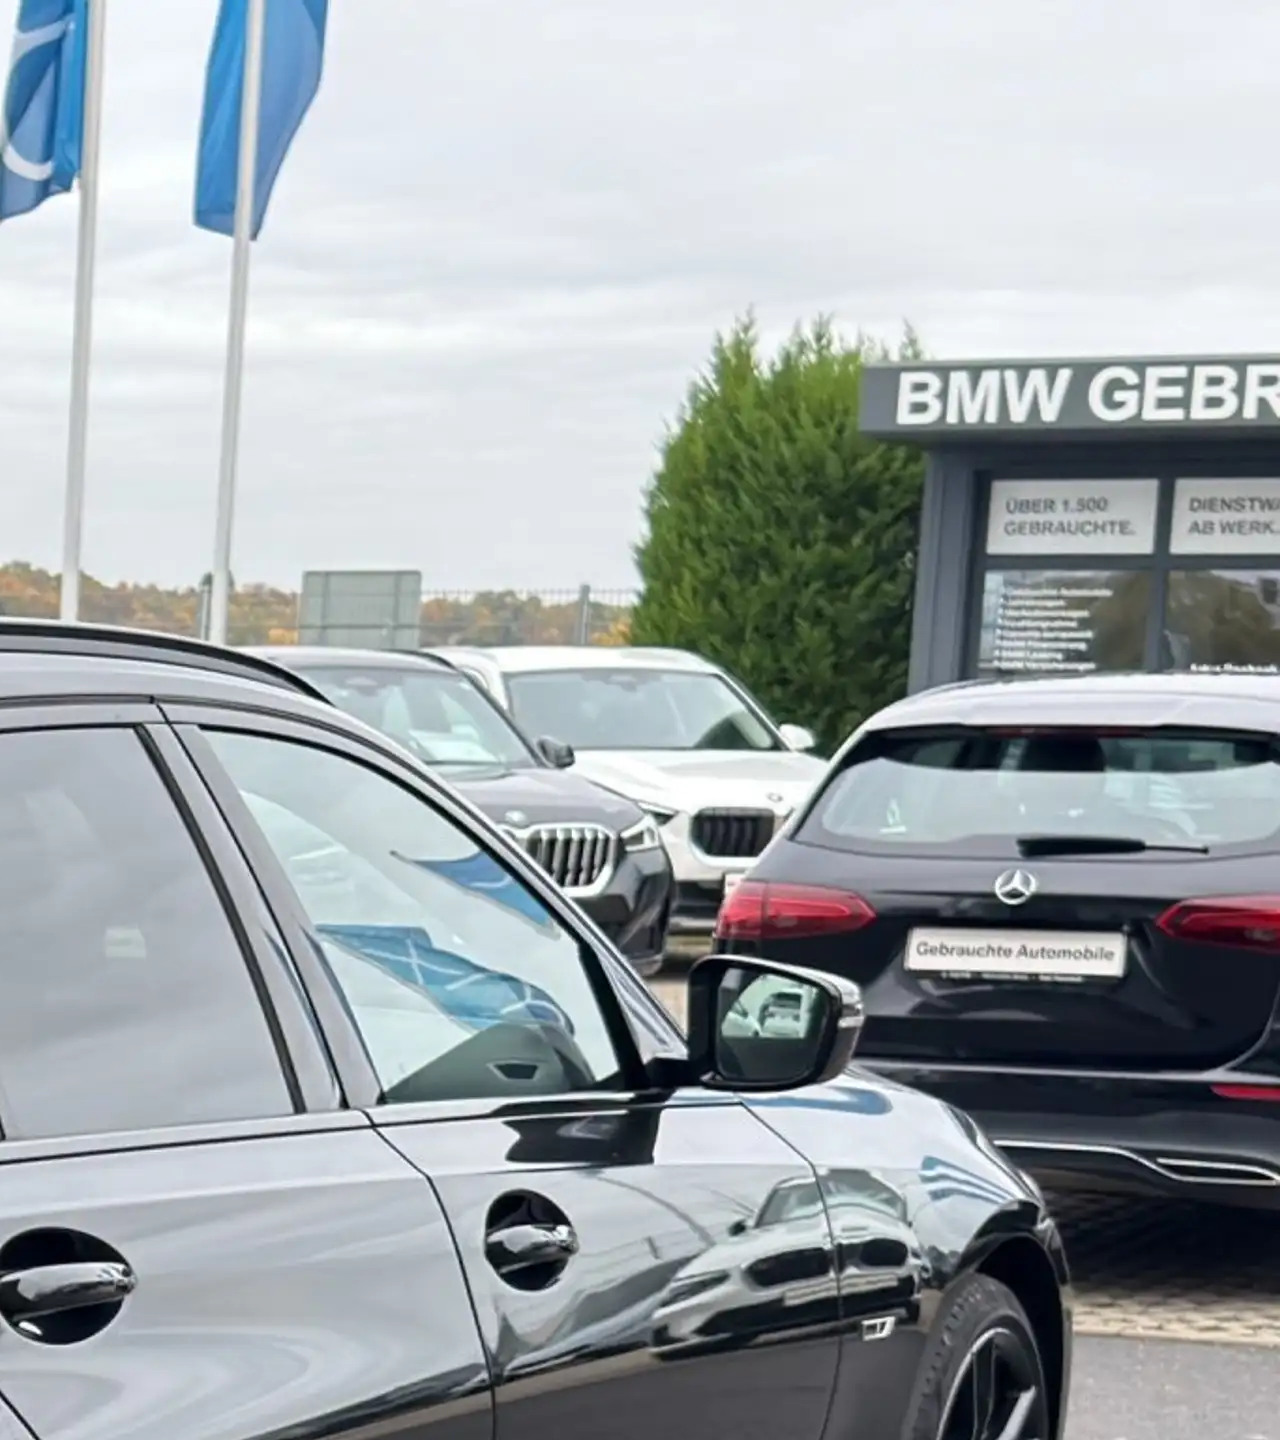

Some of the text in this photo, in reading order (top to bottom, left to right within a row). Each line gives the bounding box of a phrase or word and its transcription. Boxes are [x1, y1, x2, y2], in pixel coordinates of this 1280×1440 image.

[896, 365, 1280, 425] BMW GEBR
[916, 940, 1116, 963] Gebrauchte Automobile
